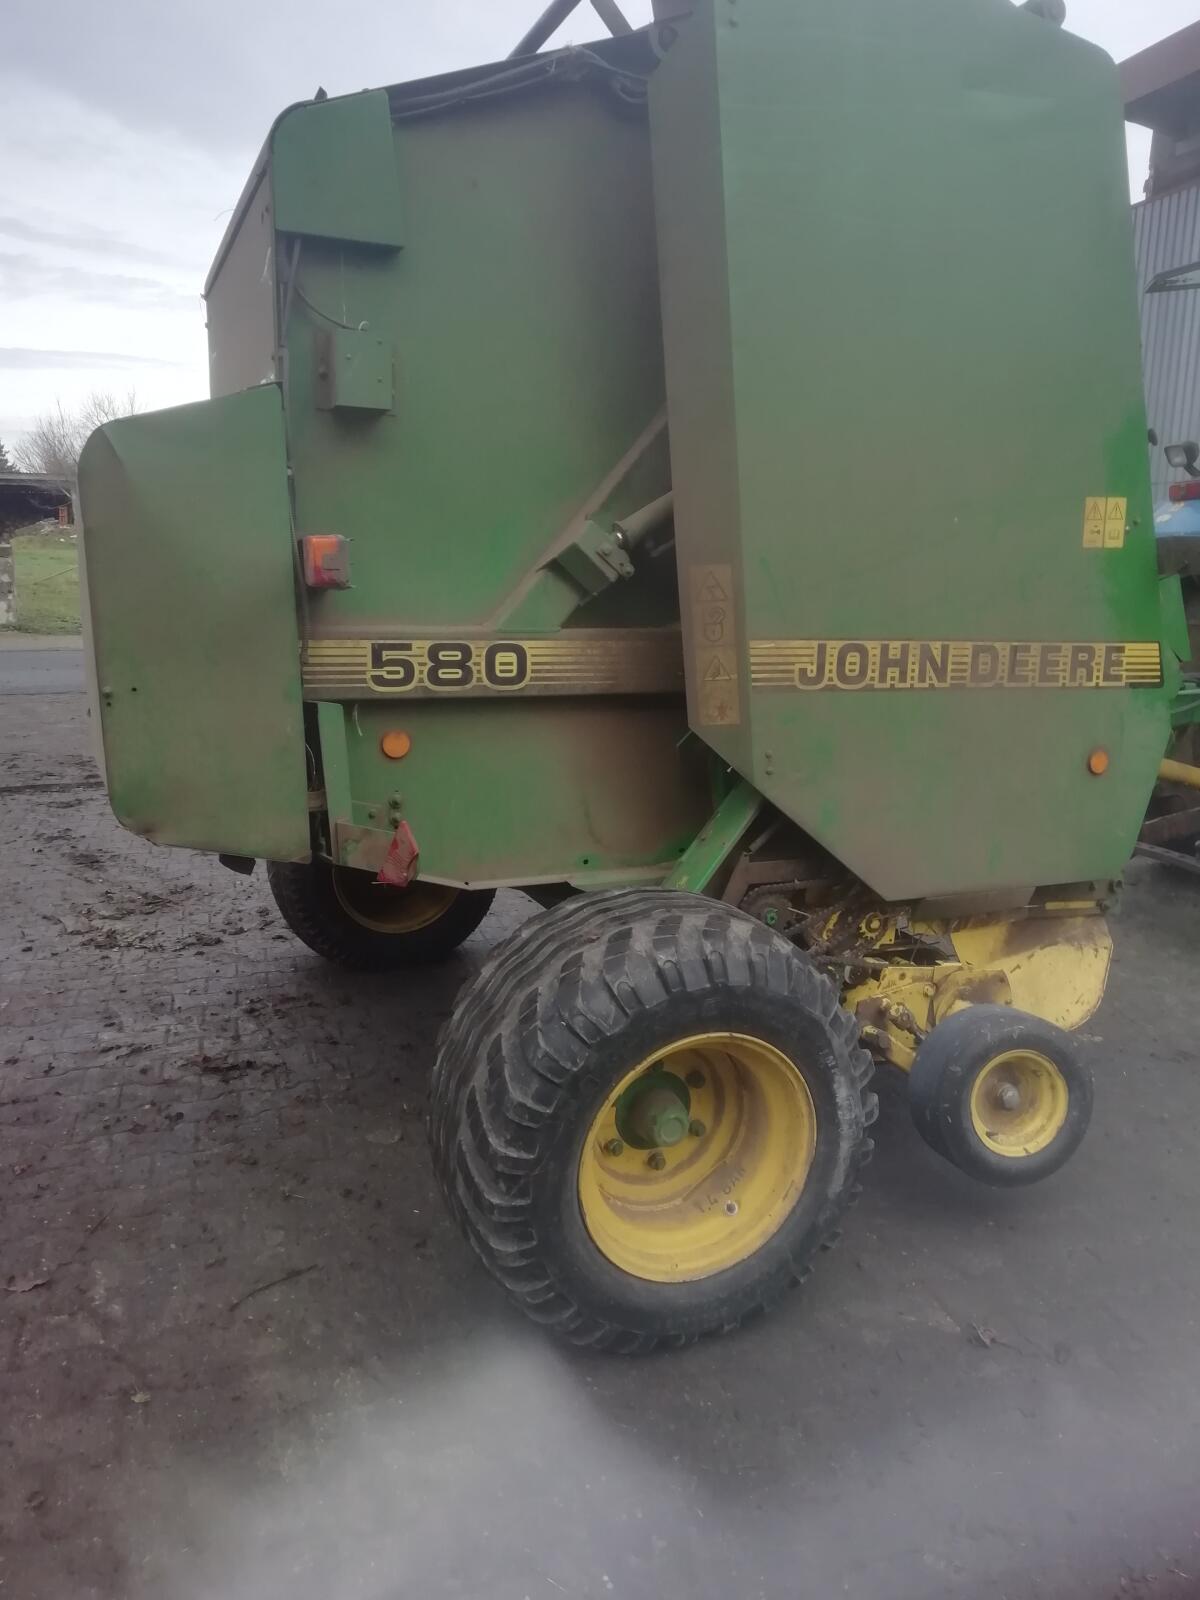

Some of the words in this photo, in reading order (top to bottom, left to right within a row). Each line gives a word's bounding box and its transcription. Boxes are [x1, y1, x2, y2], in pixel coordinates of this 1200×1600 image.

[369, 642, 529, 688] 580
[797, 642, 951, 688] JOHN
[969, 643, 1127, 687] DEERE
